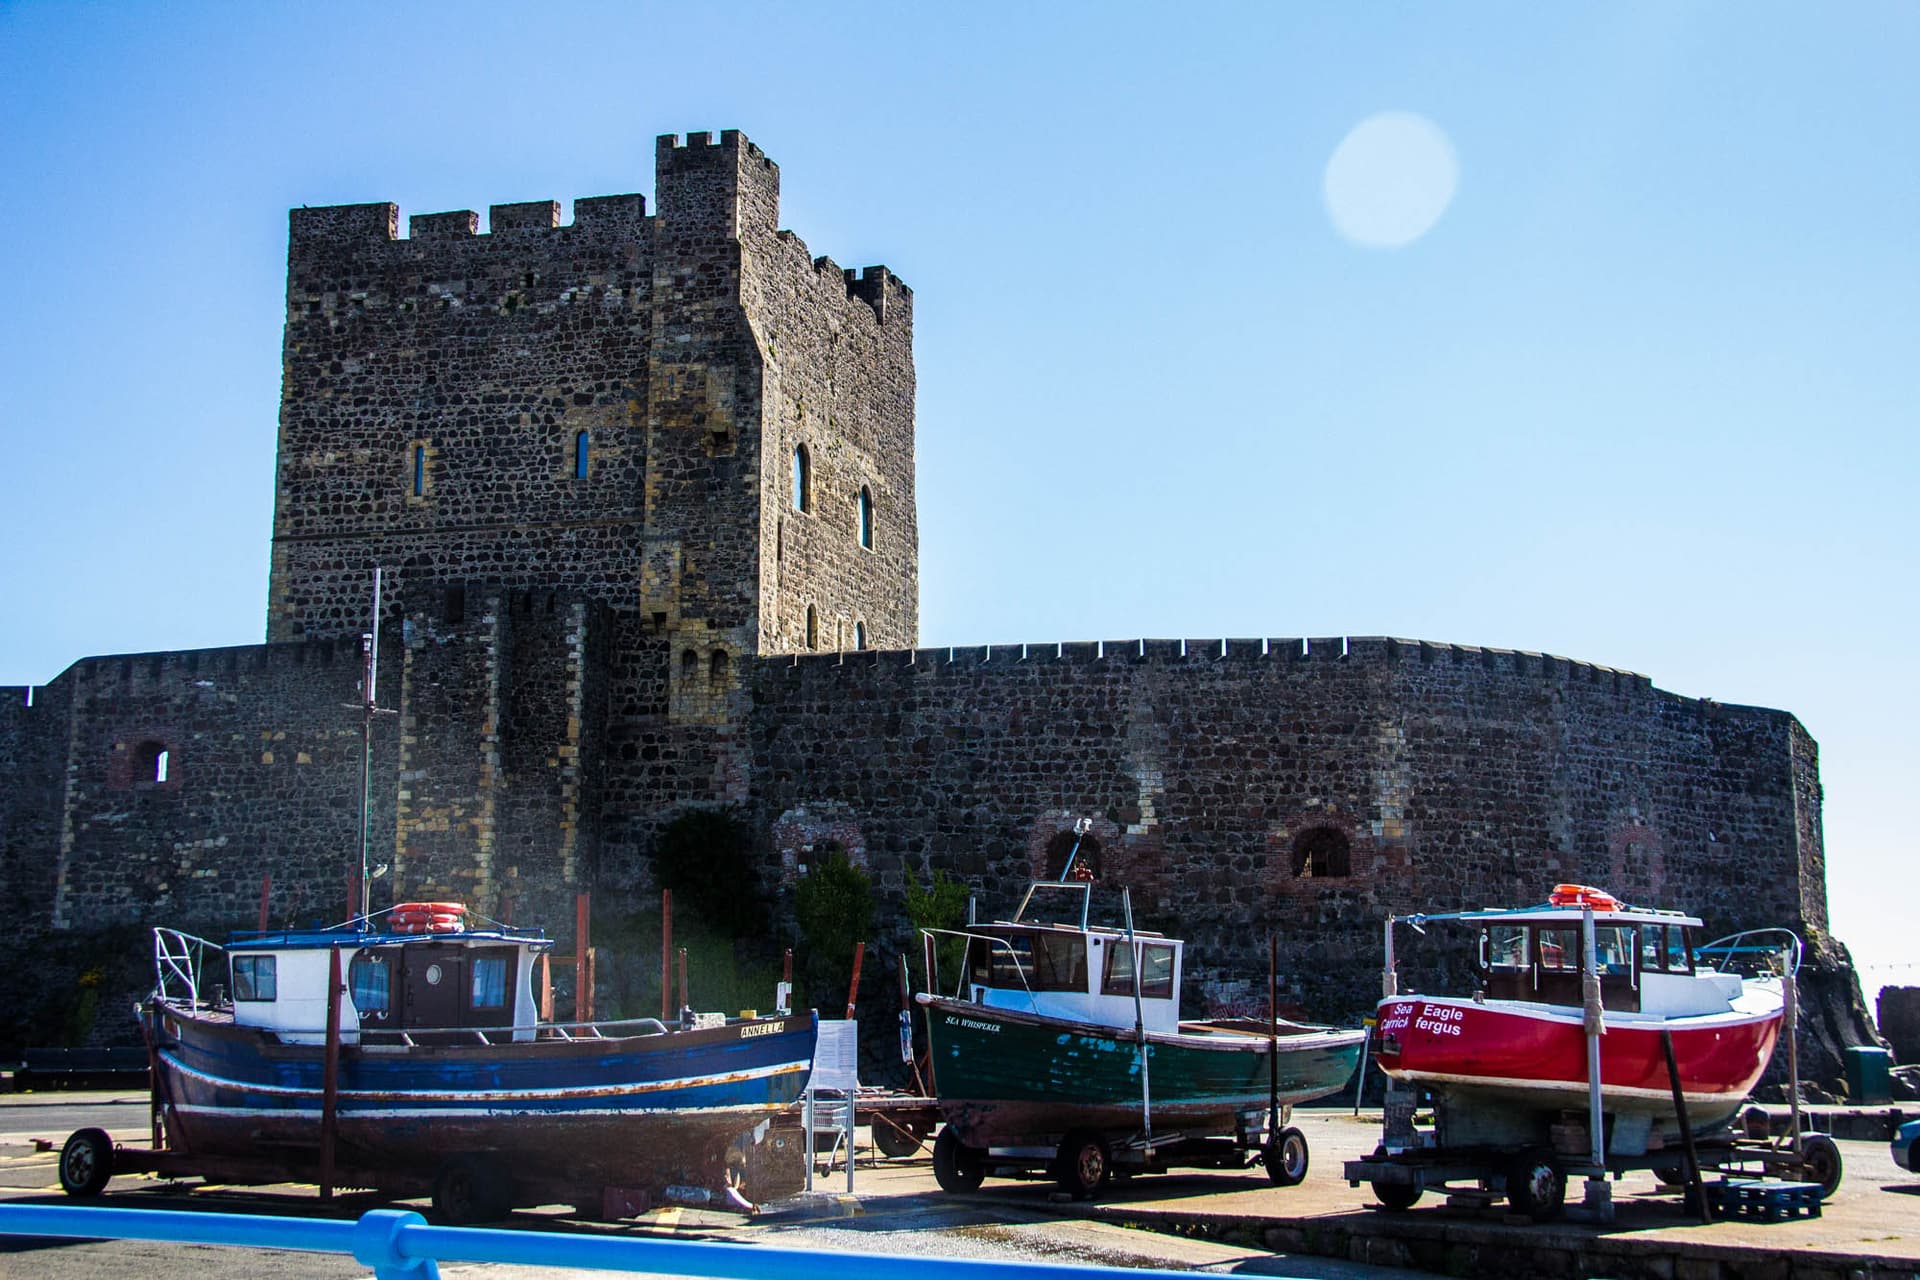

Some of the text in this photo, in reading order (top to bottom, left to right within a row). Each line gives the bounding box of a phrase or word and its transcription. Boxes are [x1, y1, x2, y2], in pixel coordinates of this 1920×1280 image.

[1394, 1003, 1463, 1021] Sea Eagle
[741, 1021, 784, 1038] ANNELLA
[945, 1015, 1001, 1032] SEA WHISPERER
[1380, 1016, 1461, 1036] Carrick fergus
